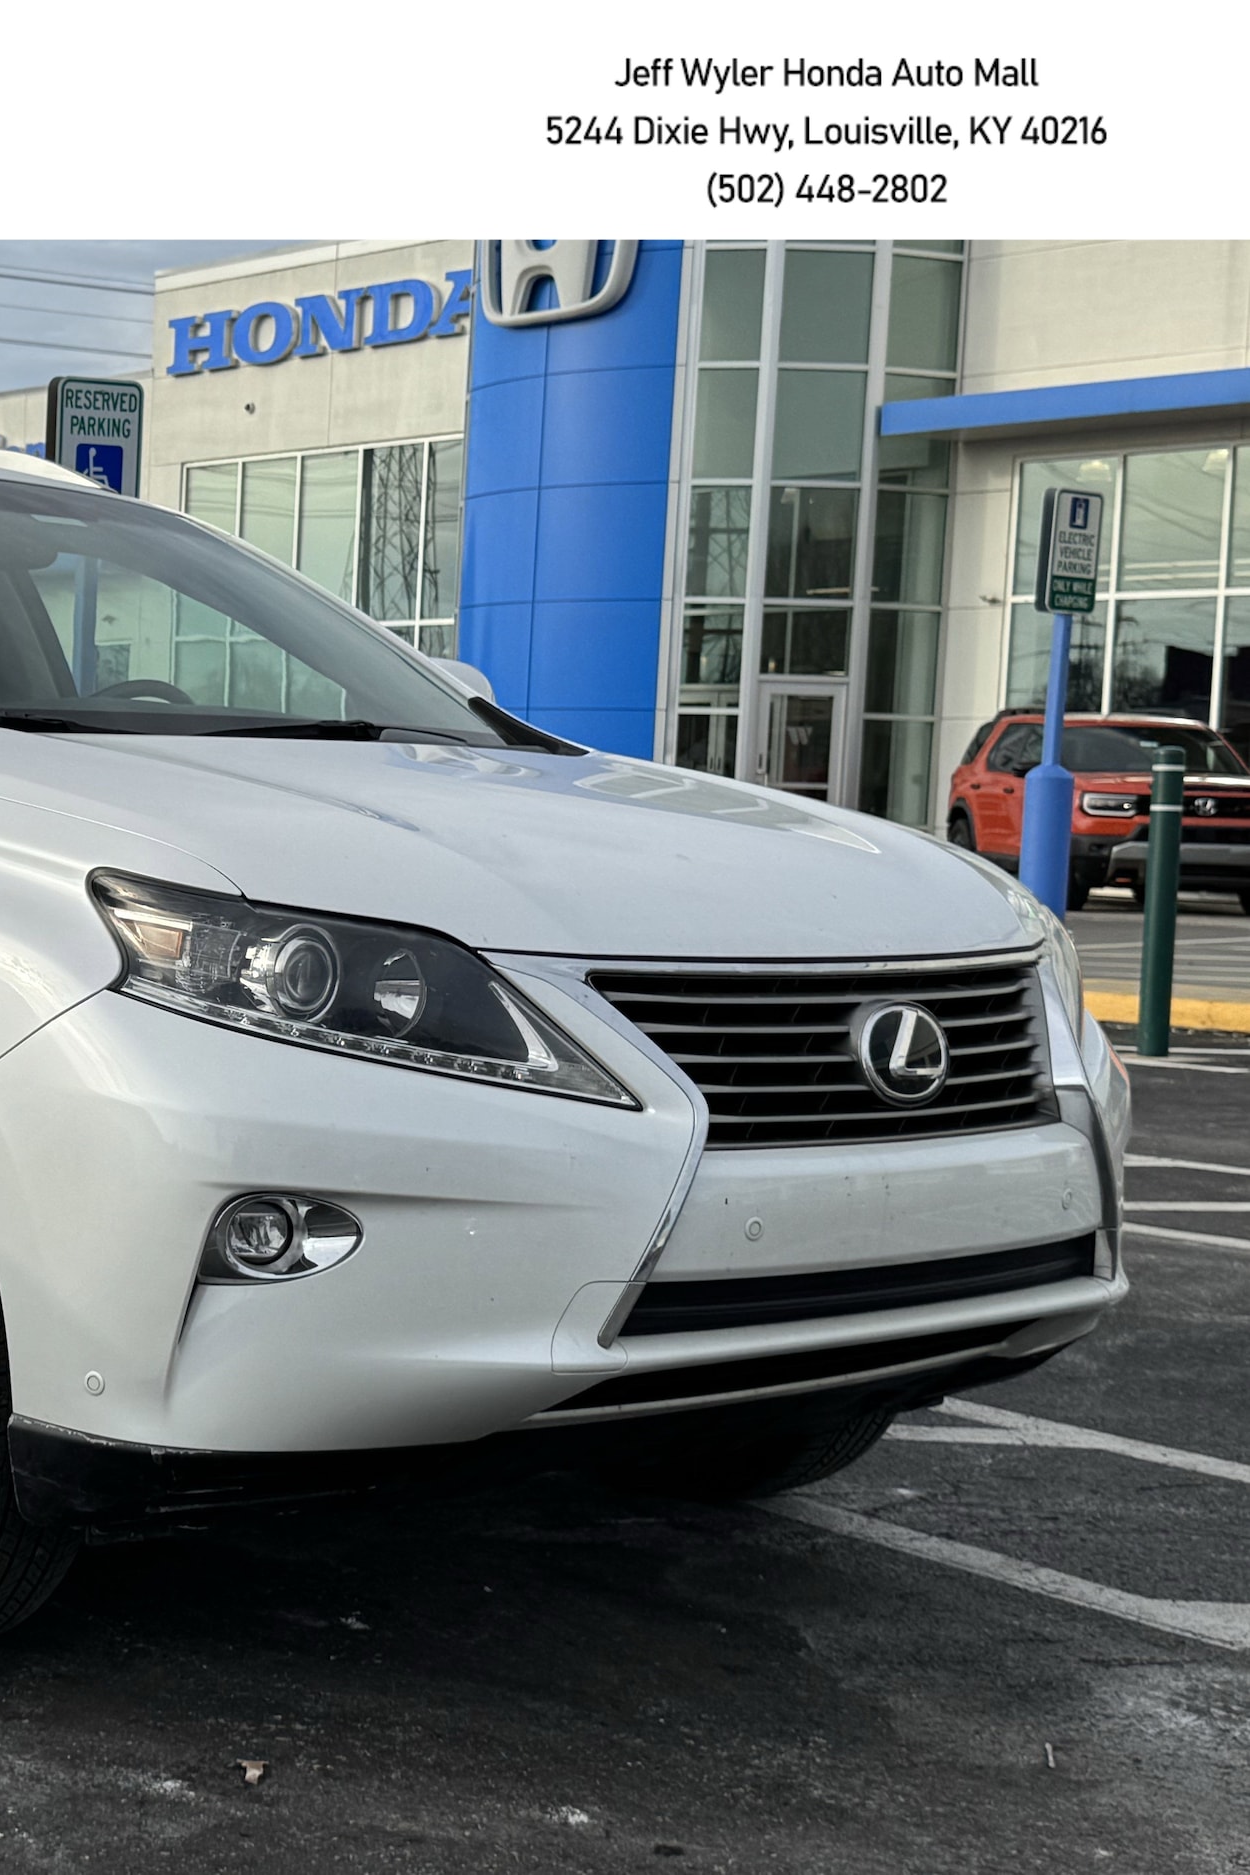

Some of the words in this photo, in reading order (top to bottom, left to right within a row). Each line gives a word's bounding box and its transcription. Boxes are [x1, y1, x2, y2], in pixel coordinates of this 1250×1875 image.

[65, 388, 138, 413] RESERVED
[70, 415, 131, 439] PARKING
[1058, 530, 1095, 547] ELECTRIC
[1059, 545, 1093, 561] VEHICLE
[1056, 560, 1092, 576] PARKING
